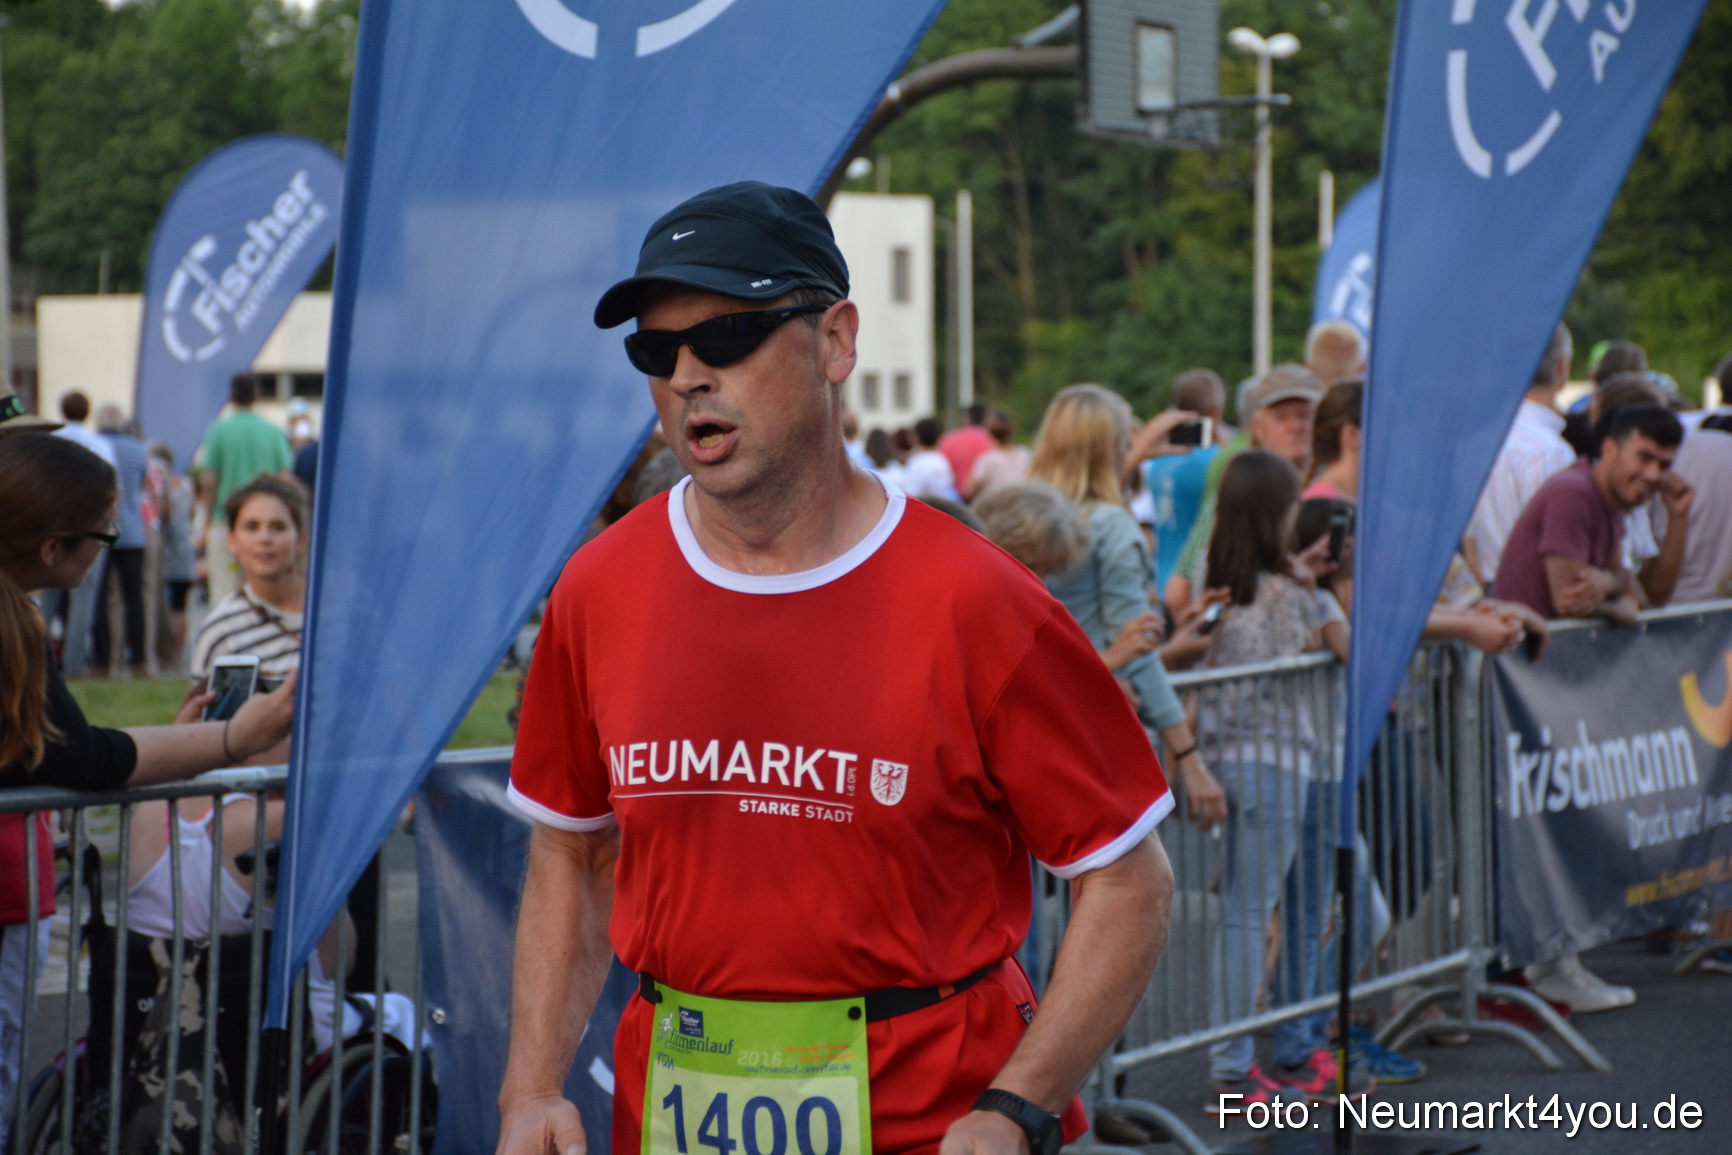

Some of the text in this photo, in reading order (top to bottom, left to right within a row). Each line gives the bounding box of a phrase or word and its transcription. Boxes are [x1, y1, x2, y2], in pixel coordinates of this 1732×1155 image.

[191, 169, 314, 334] Fischer
[609, 739, 859, 794] NEUMARKT
[738, 799, 855, 823] STARKE STADT
[1625, 799, 1672, 850] Druck
[668, 1028, 734, 1055] firmenlauf
[737, 1050, 783, 1067] 2016
[662, 1083, 843, 1155] 1400
